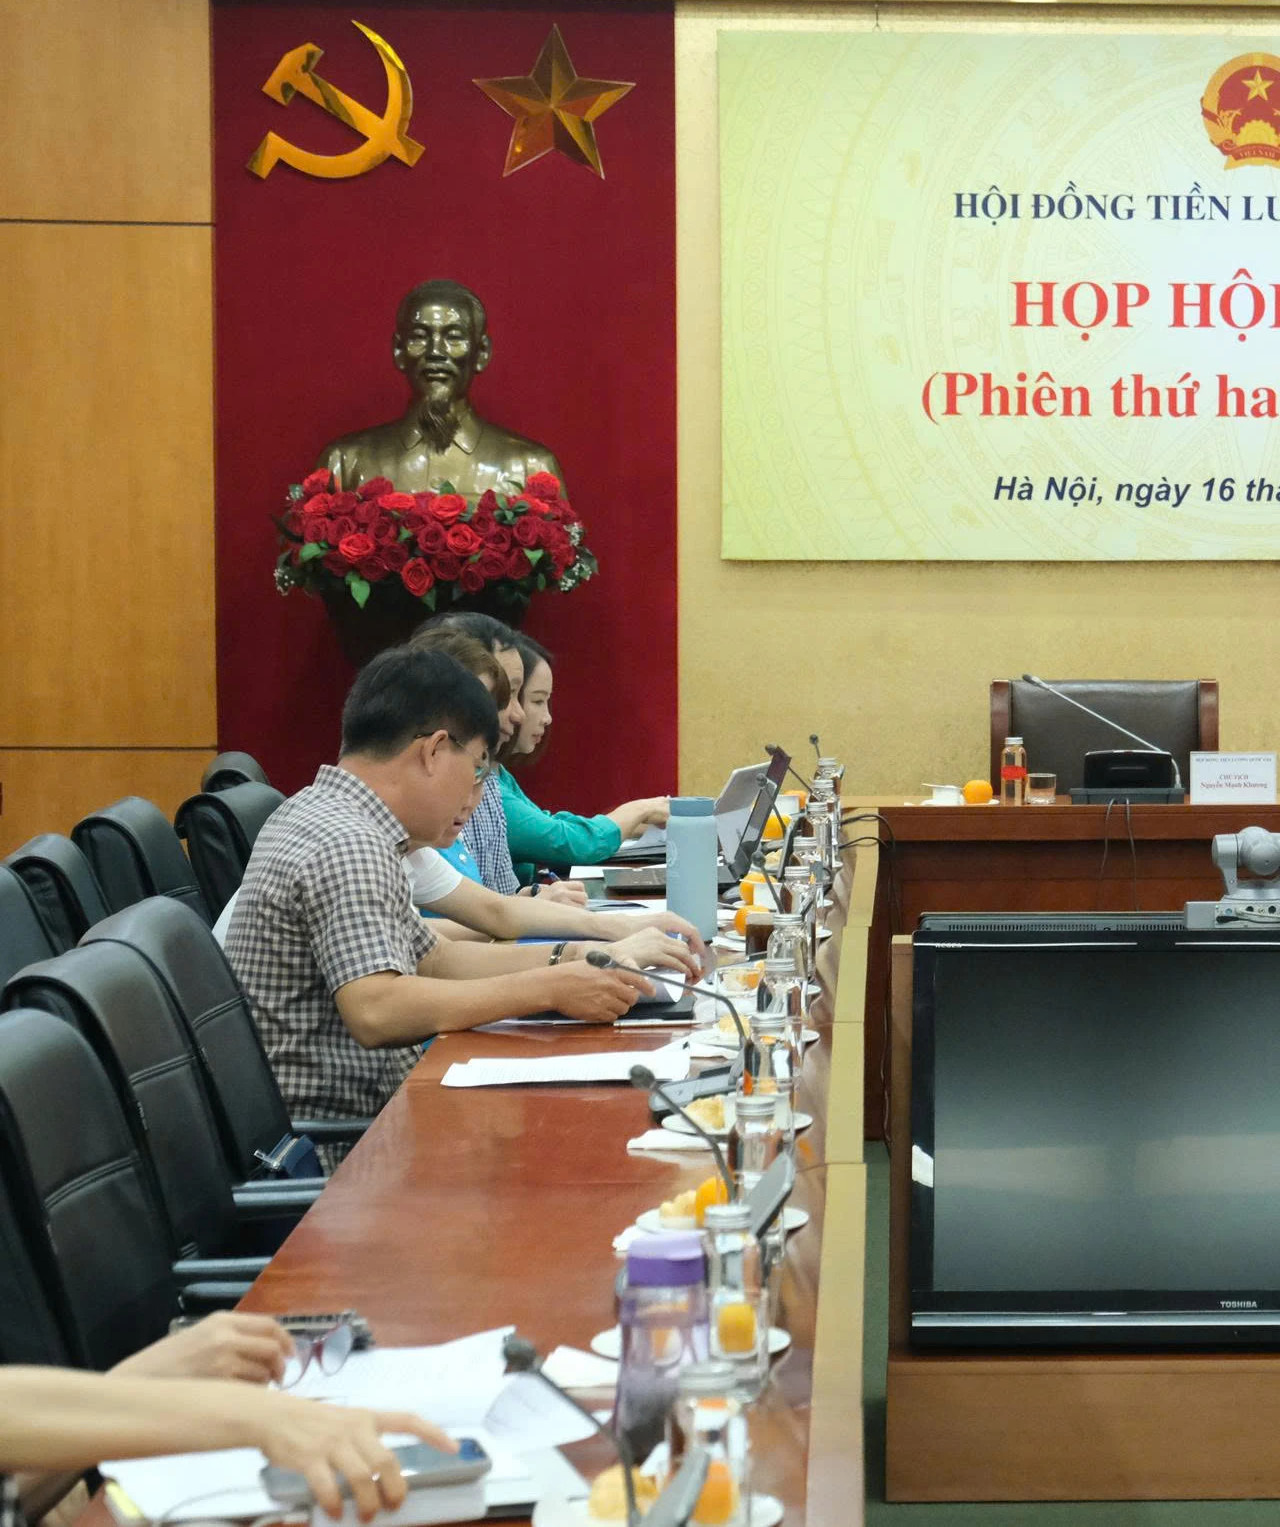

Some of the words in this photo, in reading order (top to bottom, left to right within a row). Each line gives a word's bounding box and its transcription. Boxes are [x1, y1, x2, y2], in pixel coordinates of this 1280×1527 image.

[953, 185, 1021, 226] HỘI
[1031, 181, 1134, 221] ĐỒNG
[1147, 182, 1231, 221] TIỀN
[1009, 281, 1151, 342] HỌP
[922, 371, 1091, 426] (Phiên
[1111, 373, 1201, 419] thứ
[993, 476, 1034, 502] Hà
[1044, 476, 1103, 507] Nội,
[1115, 476, 1193, 509] ngày
[1202, 478, 1236, 502] 16
[1219, 1301, 1258, 1309] TOSHIBA
